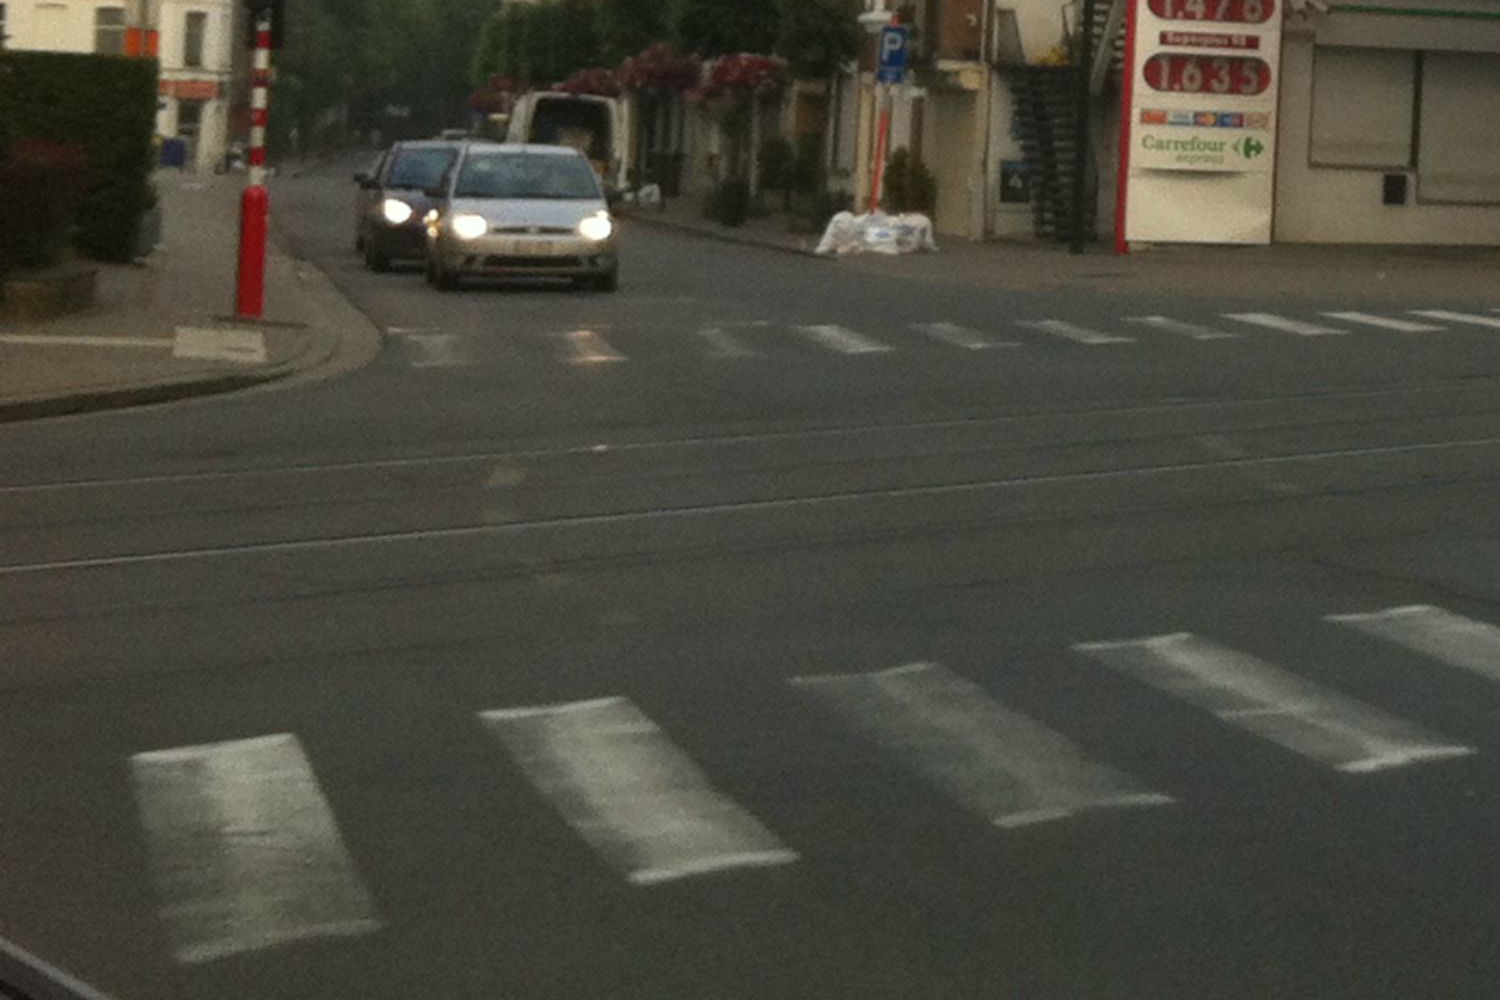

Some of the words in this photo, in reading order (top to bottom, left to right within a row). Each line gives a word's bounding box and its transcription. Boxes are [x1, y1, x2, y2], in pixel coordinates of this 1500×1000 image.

[882, 31, 903, 61] P
[1158, 57, 1259, 95] 1.635
[1142, 134, 1228, 152] Carrefour
